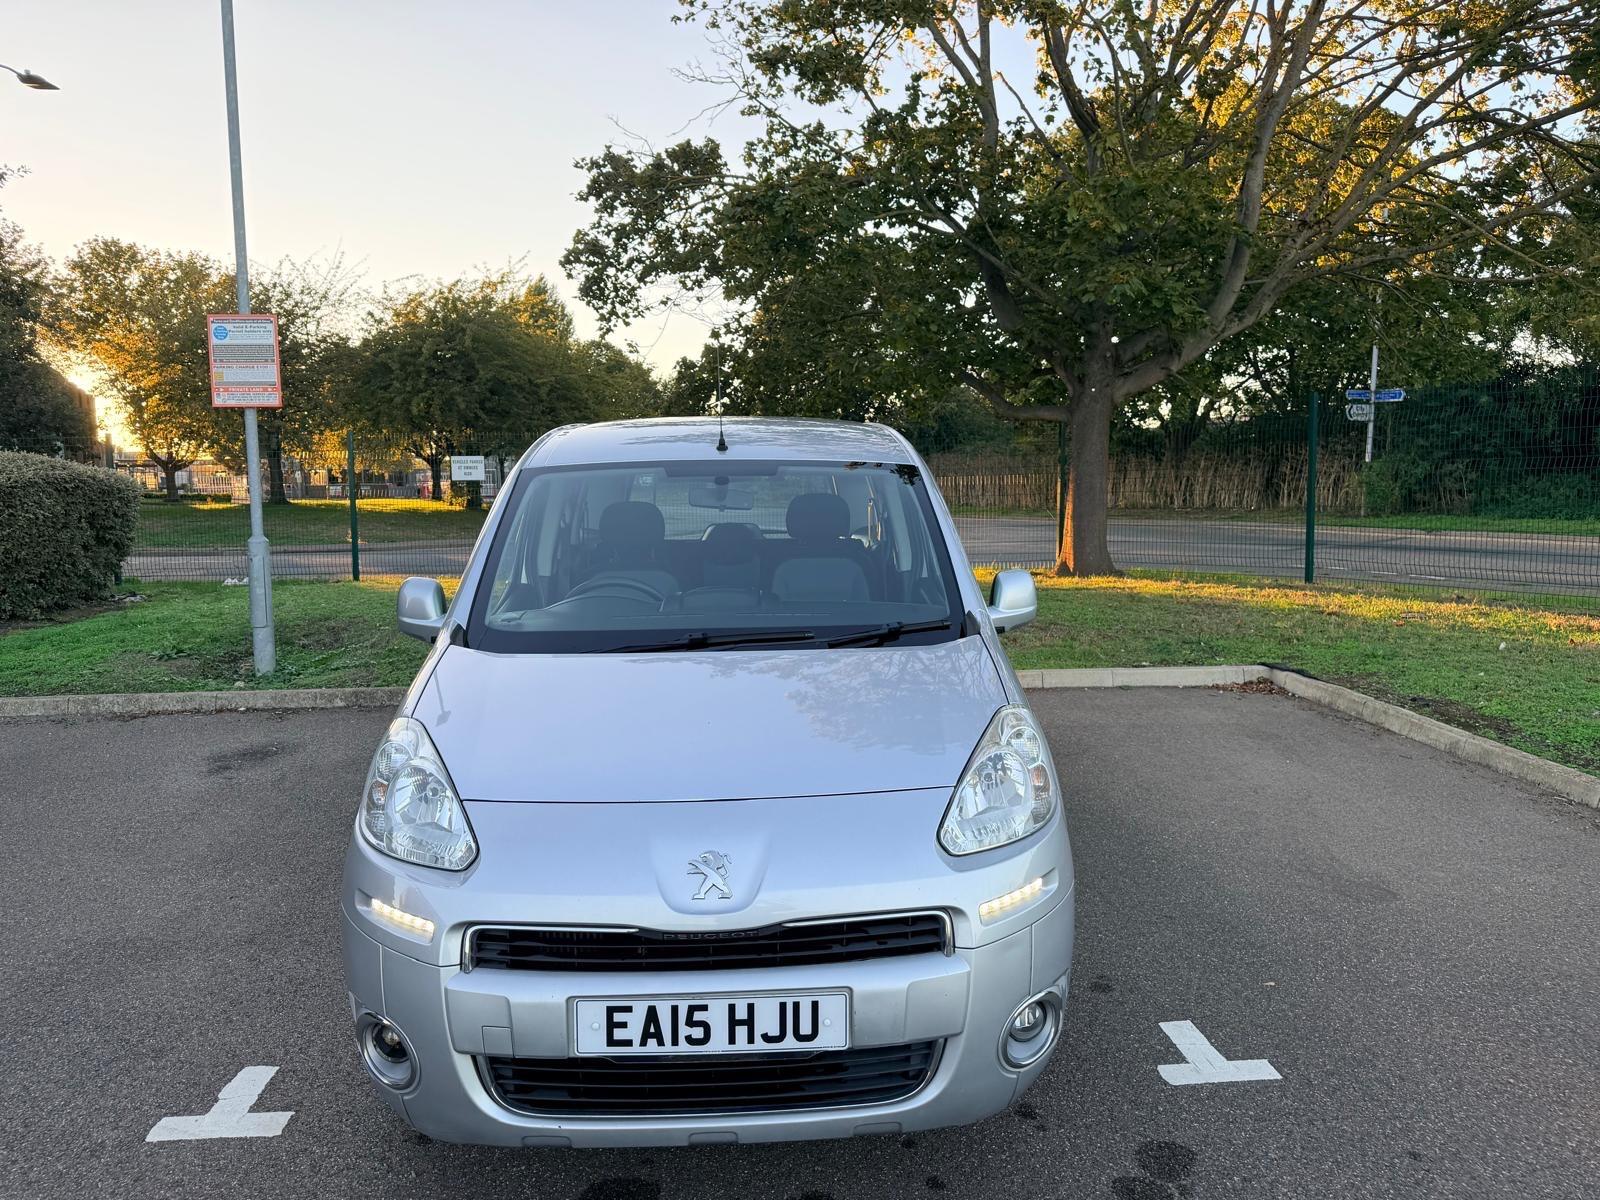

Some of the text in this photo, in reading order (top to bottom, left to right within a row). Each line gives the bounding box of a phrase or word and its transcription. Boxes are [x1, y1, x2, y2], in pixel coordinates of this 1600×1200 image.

[664, 931, 757, 940] PEUGEOT
[605, 1000, 820, 1048] EA15 HJU
